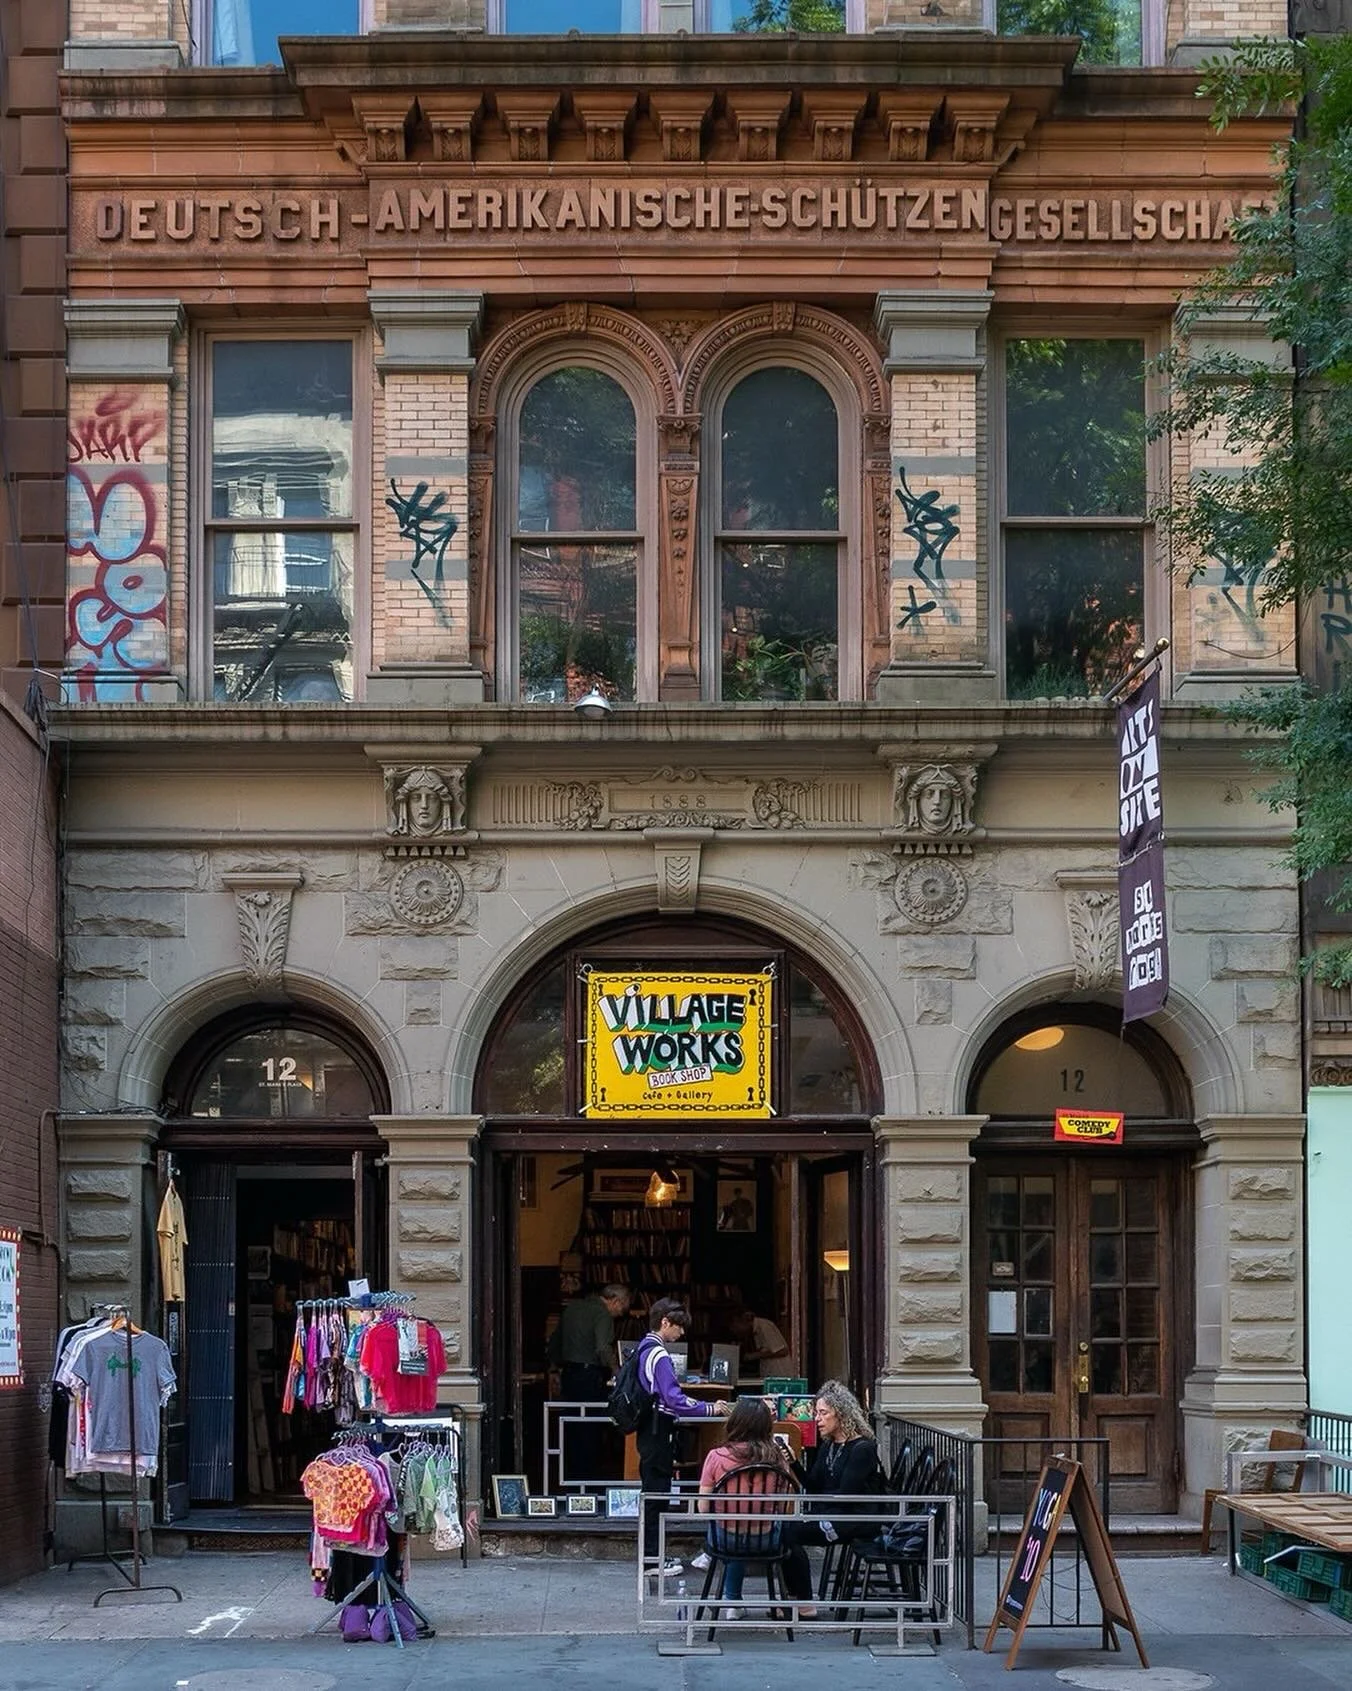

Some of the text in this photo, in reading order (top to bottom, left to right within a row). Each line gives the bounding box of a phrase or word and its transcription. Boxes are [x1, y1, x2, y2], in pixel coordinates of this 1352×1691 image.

[649, 794, 706, 809] 1888
[613, 1031, 745, 1075] WORKS
[262, 1057, 297, 1081] 12
[651, 1067, 708, 1088] BOOK SHOP
[1060, 1068, 1085, 1093] 12
[1067, 1119, 1111, 1129] COMEDY
[1076, 1126, 1103, 1134] CLUB
